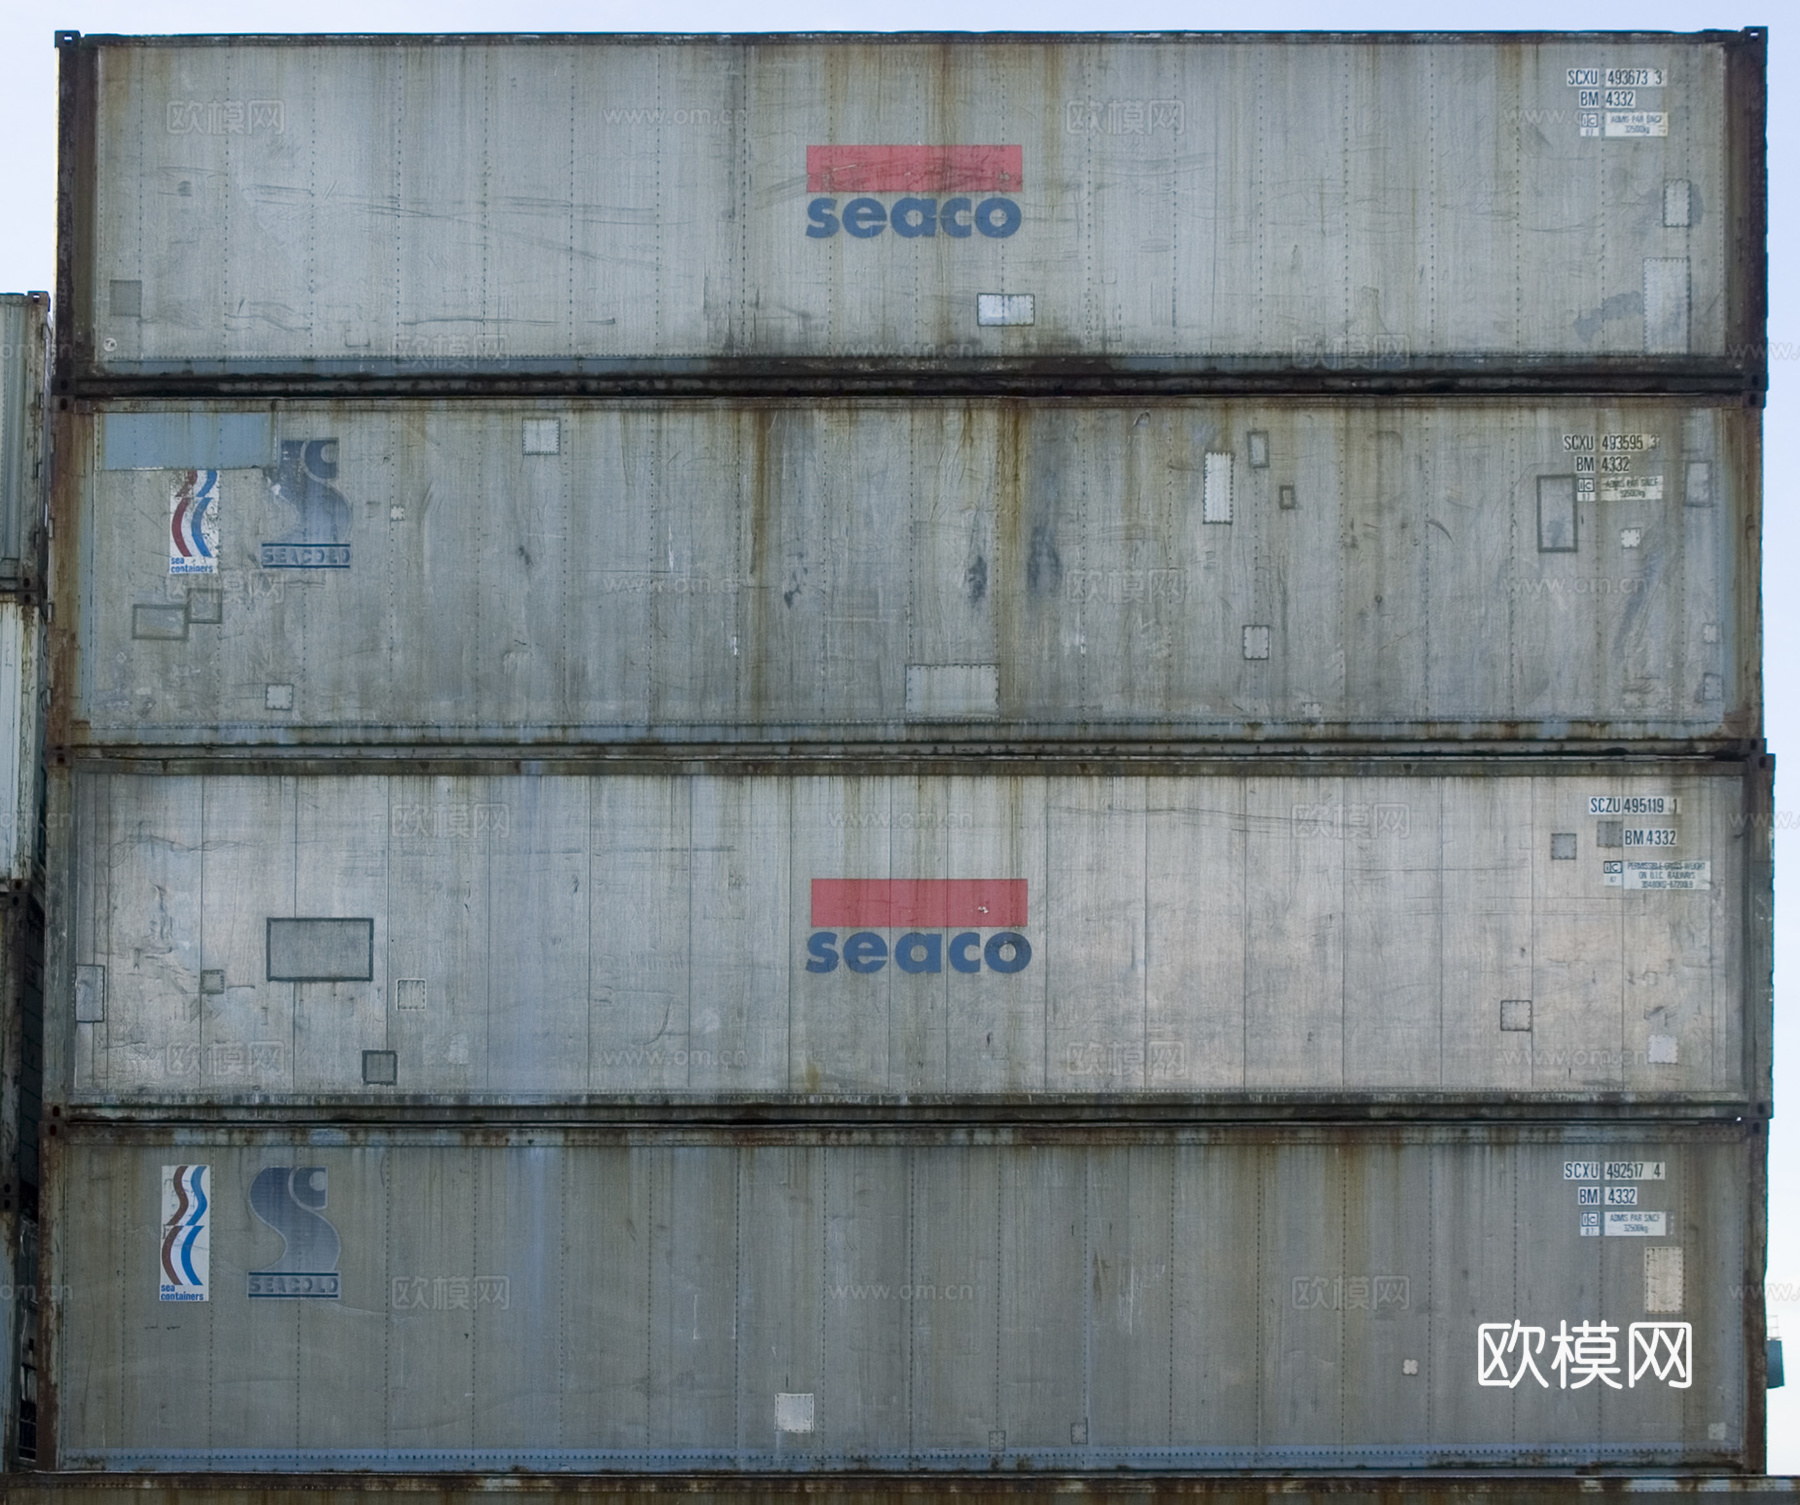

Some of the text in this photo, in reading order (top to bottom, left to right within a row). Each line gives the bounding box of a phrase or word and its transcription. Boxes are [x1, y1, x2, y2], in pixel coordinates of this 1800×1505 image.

[1568, 70, 1662, 85] SCXU 493673 3
[1580, 91, 1635, 106] BM 4332
[805, 197, 1022, 238] seaco
[1564, 435, 1594, 450] SCXU
[1602, 435, 1643, 450] 493595
[1576, 457, 1629, 471] BM 4332
[171, 557, 185, 565] sea
[262, 548, 350, 564] SEACOLD
[171, 565, 214, 573] containers
[1590, 797, 1621, 813] SCZU
[1624, 797, 1664, 813] 495119
[1625, 830, 1677, 845] BM 4332
[805, 931, 1032, 974] seaco
[1565, 1163, 1661, 1178] SCXU 492517 4
[1580, 1189, 1635, 1204] BM 4332
[161, 1284, 175, 1292] sea
[249, 1277, 338, 1293] SEACOLD
[161, 1292, 204, 1300] containers
